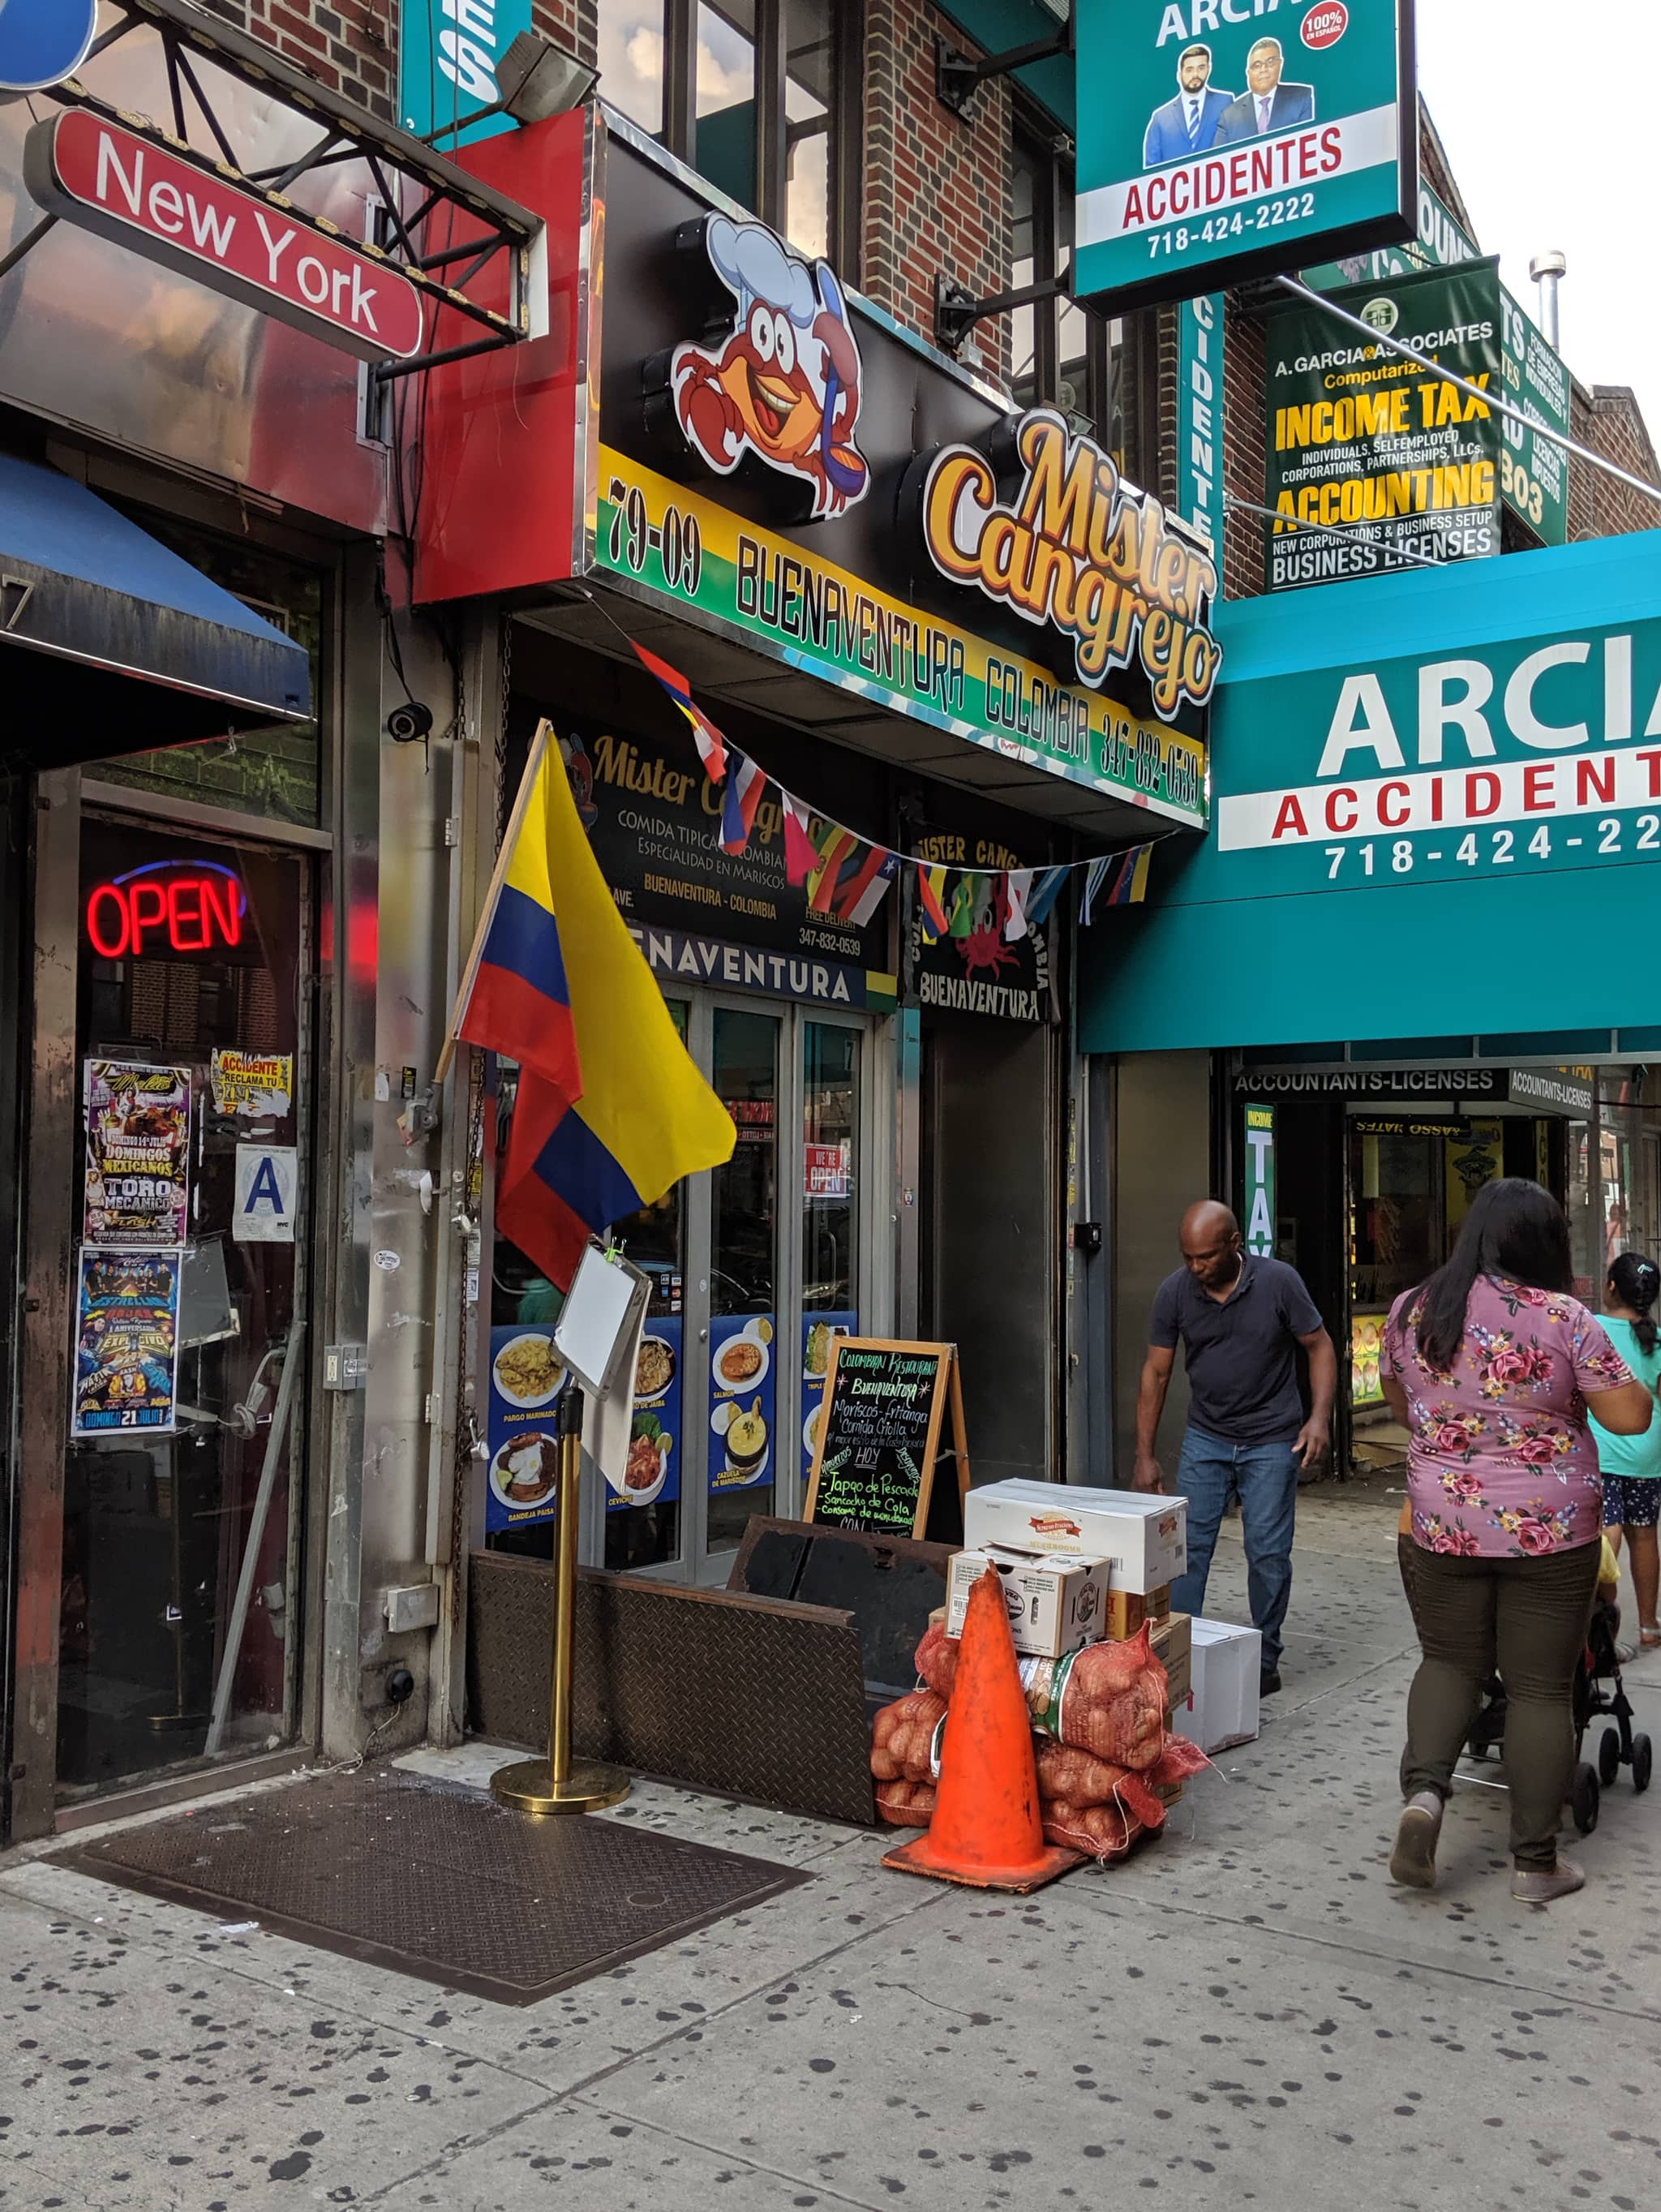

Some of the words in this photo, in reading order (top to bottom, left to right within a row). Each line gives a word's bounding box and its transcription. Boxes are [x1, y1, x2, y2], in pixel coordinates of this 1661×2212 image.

[1155, 0, 1298, 48] ARC
[1306, 10, 1342, 32] 100%
[1306, 31, 1315, 41] EN
[1315, 24, 1342, 38] ESPAÑOL
[1122, 126, 1342, 230] ACCIDENTES
[96, 131, 236, 258] New
[255, 211, 379, 333] York
[1148, 192, 1315, 259] 718-424-2222
[1275, 388, 1410, 451] INCOME
[1418, 372, 1491, 428] TAX
[1373, 430, 1459, 453] SELFEMPLOYED
[1453, 442, 1484, 459] LLCs.
[1273, 460, 1494, 534] ACCOUNTING
[1022, 414, 1217, 623] Mister
[1273, 539, 1298, 556] NEW
[1384, 526, 1393, 538] &
[1397, 516, 1452, 536] BUSINESS
[1456, 511, 1492, 528] SETUP
[1273, 546, 1377, 584] BUSINESS
[1384, 528, 1491, 567] LICENSES
[928, 456, 1219, 709] Cangrejo
[608, 476, 702, 597] 79-09
[736, 532, 966, 714] BUENAVENTURA
[985, 655, 1089, 763] COLOMBIA
[1100, 712, 1200, 809] 347-832-0539
[594, 735, 696, 805] Mister
[618, 810, 675, 840] COMIDA
[677, 825, 719, 852] TIPICA
[637, 837, 714, 871] ESPECIALIDAD
[716, 859, 730, 877] EN
[644, 873, 722, 908] BUENAVENTURA
[730, 894, 777, 921] COLOMBIA
[87, 879, 240, 959] OPEN
[805, 907, 824, 922] FREE
[799, 927, 861, 956] 347-832-0539
[627, 927, 851, 1003] ENAVENTURA
[920, 972, 1041, 1021] BUENAVENTURA
[222, 1055, 278, 1076] ACCIDENTE
[225, 1073, 264, 1085] RECLAMA
[266, 1077, 277, 1087] TU
[1512, 1071, 1591, 1110] ACCOUNTANTS-LICENSES
[1247, 1110, 1273, 1128] INCOME
[105, 1145, 171, 1162] DOMINGOS
[816, 1151, 835, 1166] WE'RE
[102, 1159, 174, 1176] MEXICANOS
[810, 1166, 843, 1192] OPEN
[104, 1178, 172, 1198] TORO
[244, 1157, 285, 1213] A
[85, 1411, 121, 1428] DOMINGO
[121, 1410, 137, 1426] 21
[137, 1408, 159, 1424] JULIO
[504, 1414, 525, 1423] PARGO
[842, 1419, 873, 1435] Comida
[876, 1419, 908, 1436] Criolla
[855, 1446, 881, 1465] HOY
[865, 1473, 879, 1493] de
[537, 1508, 554, 1517] PAISA
[608, 1494, 633, 1506] CEVICHE
[860, 1505, 873, 1519] de
[869, 1494, 882, 1508] de
[885, 1499, 909, 1516] Cola
